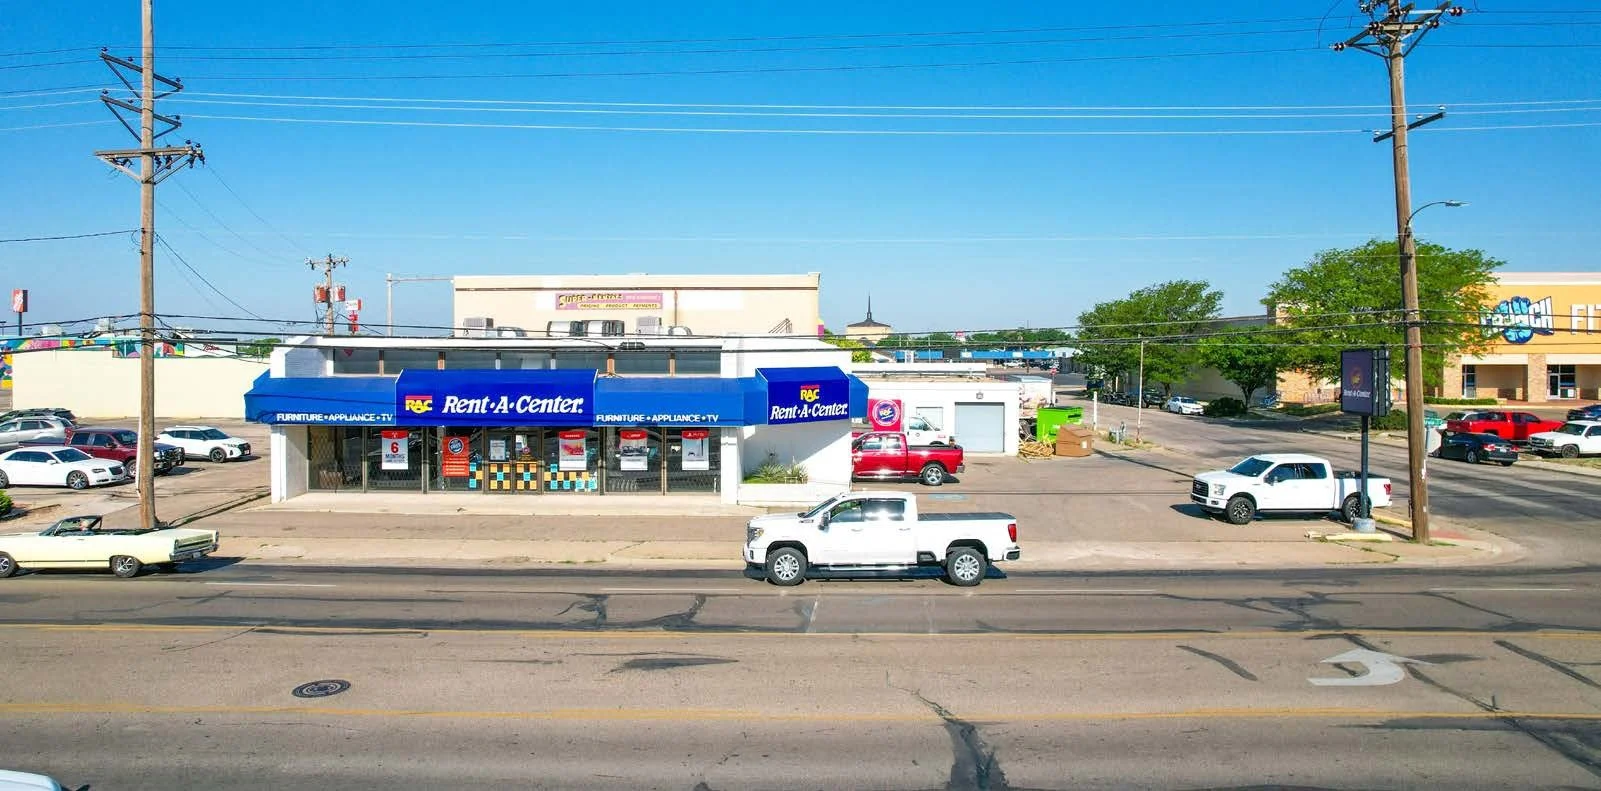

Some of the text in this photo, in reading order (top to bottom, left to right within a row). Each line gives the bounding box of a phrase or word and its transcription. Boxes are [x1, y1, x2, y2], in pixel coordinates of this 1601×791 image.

[800, 389, 820, 402] RAC
[405, 399, 433, 414] RAC
[276, 413, 393, 422] FURNITURE APPLIANCE TV
[596, 414, 719, 423] FURNITURE APPLIANCE TV
[390, 442, 399, 453] 6
